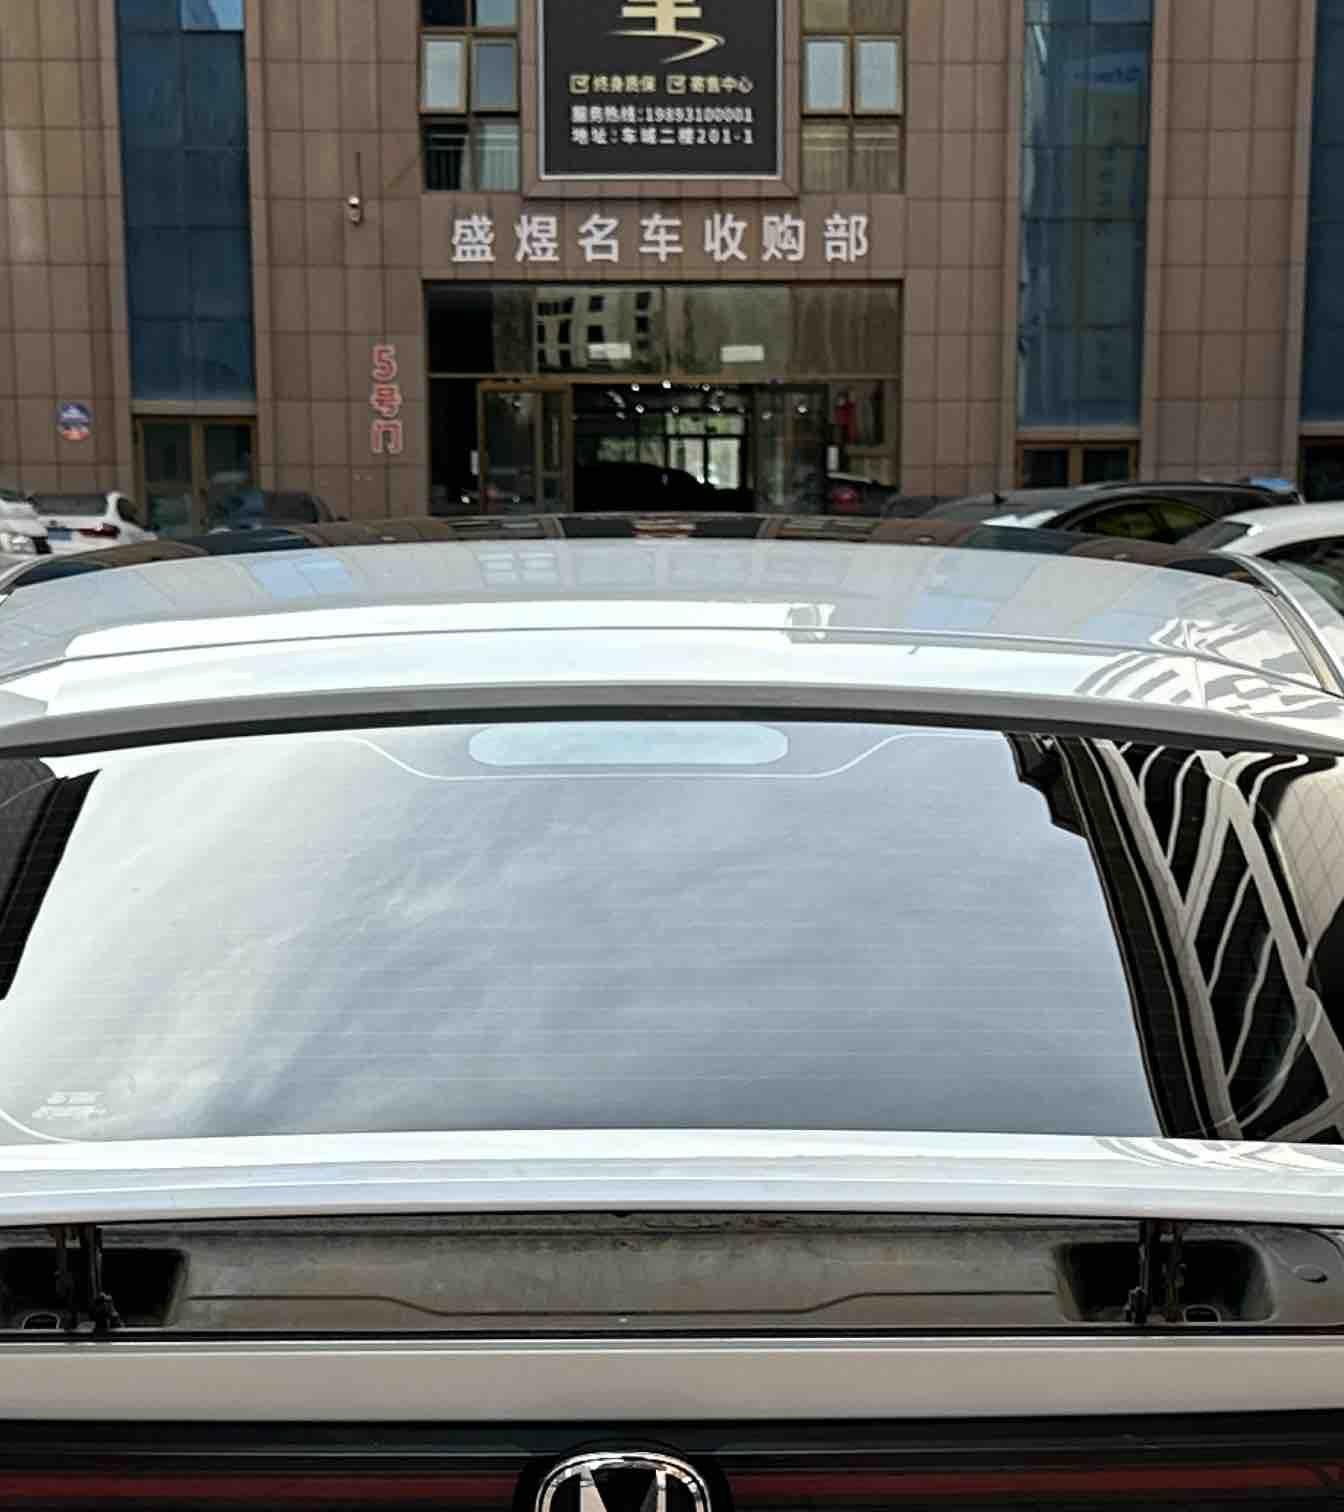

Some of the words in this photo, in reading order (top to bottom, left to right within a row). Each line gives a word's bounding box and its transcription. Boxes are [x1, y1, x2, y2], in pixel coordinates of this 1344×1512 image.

[451, 212, 870, 264] 盛煜名车收购部
[371, 343, 402, 456] 5号门
